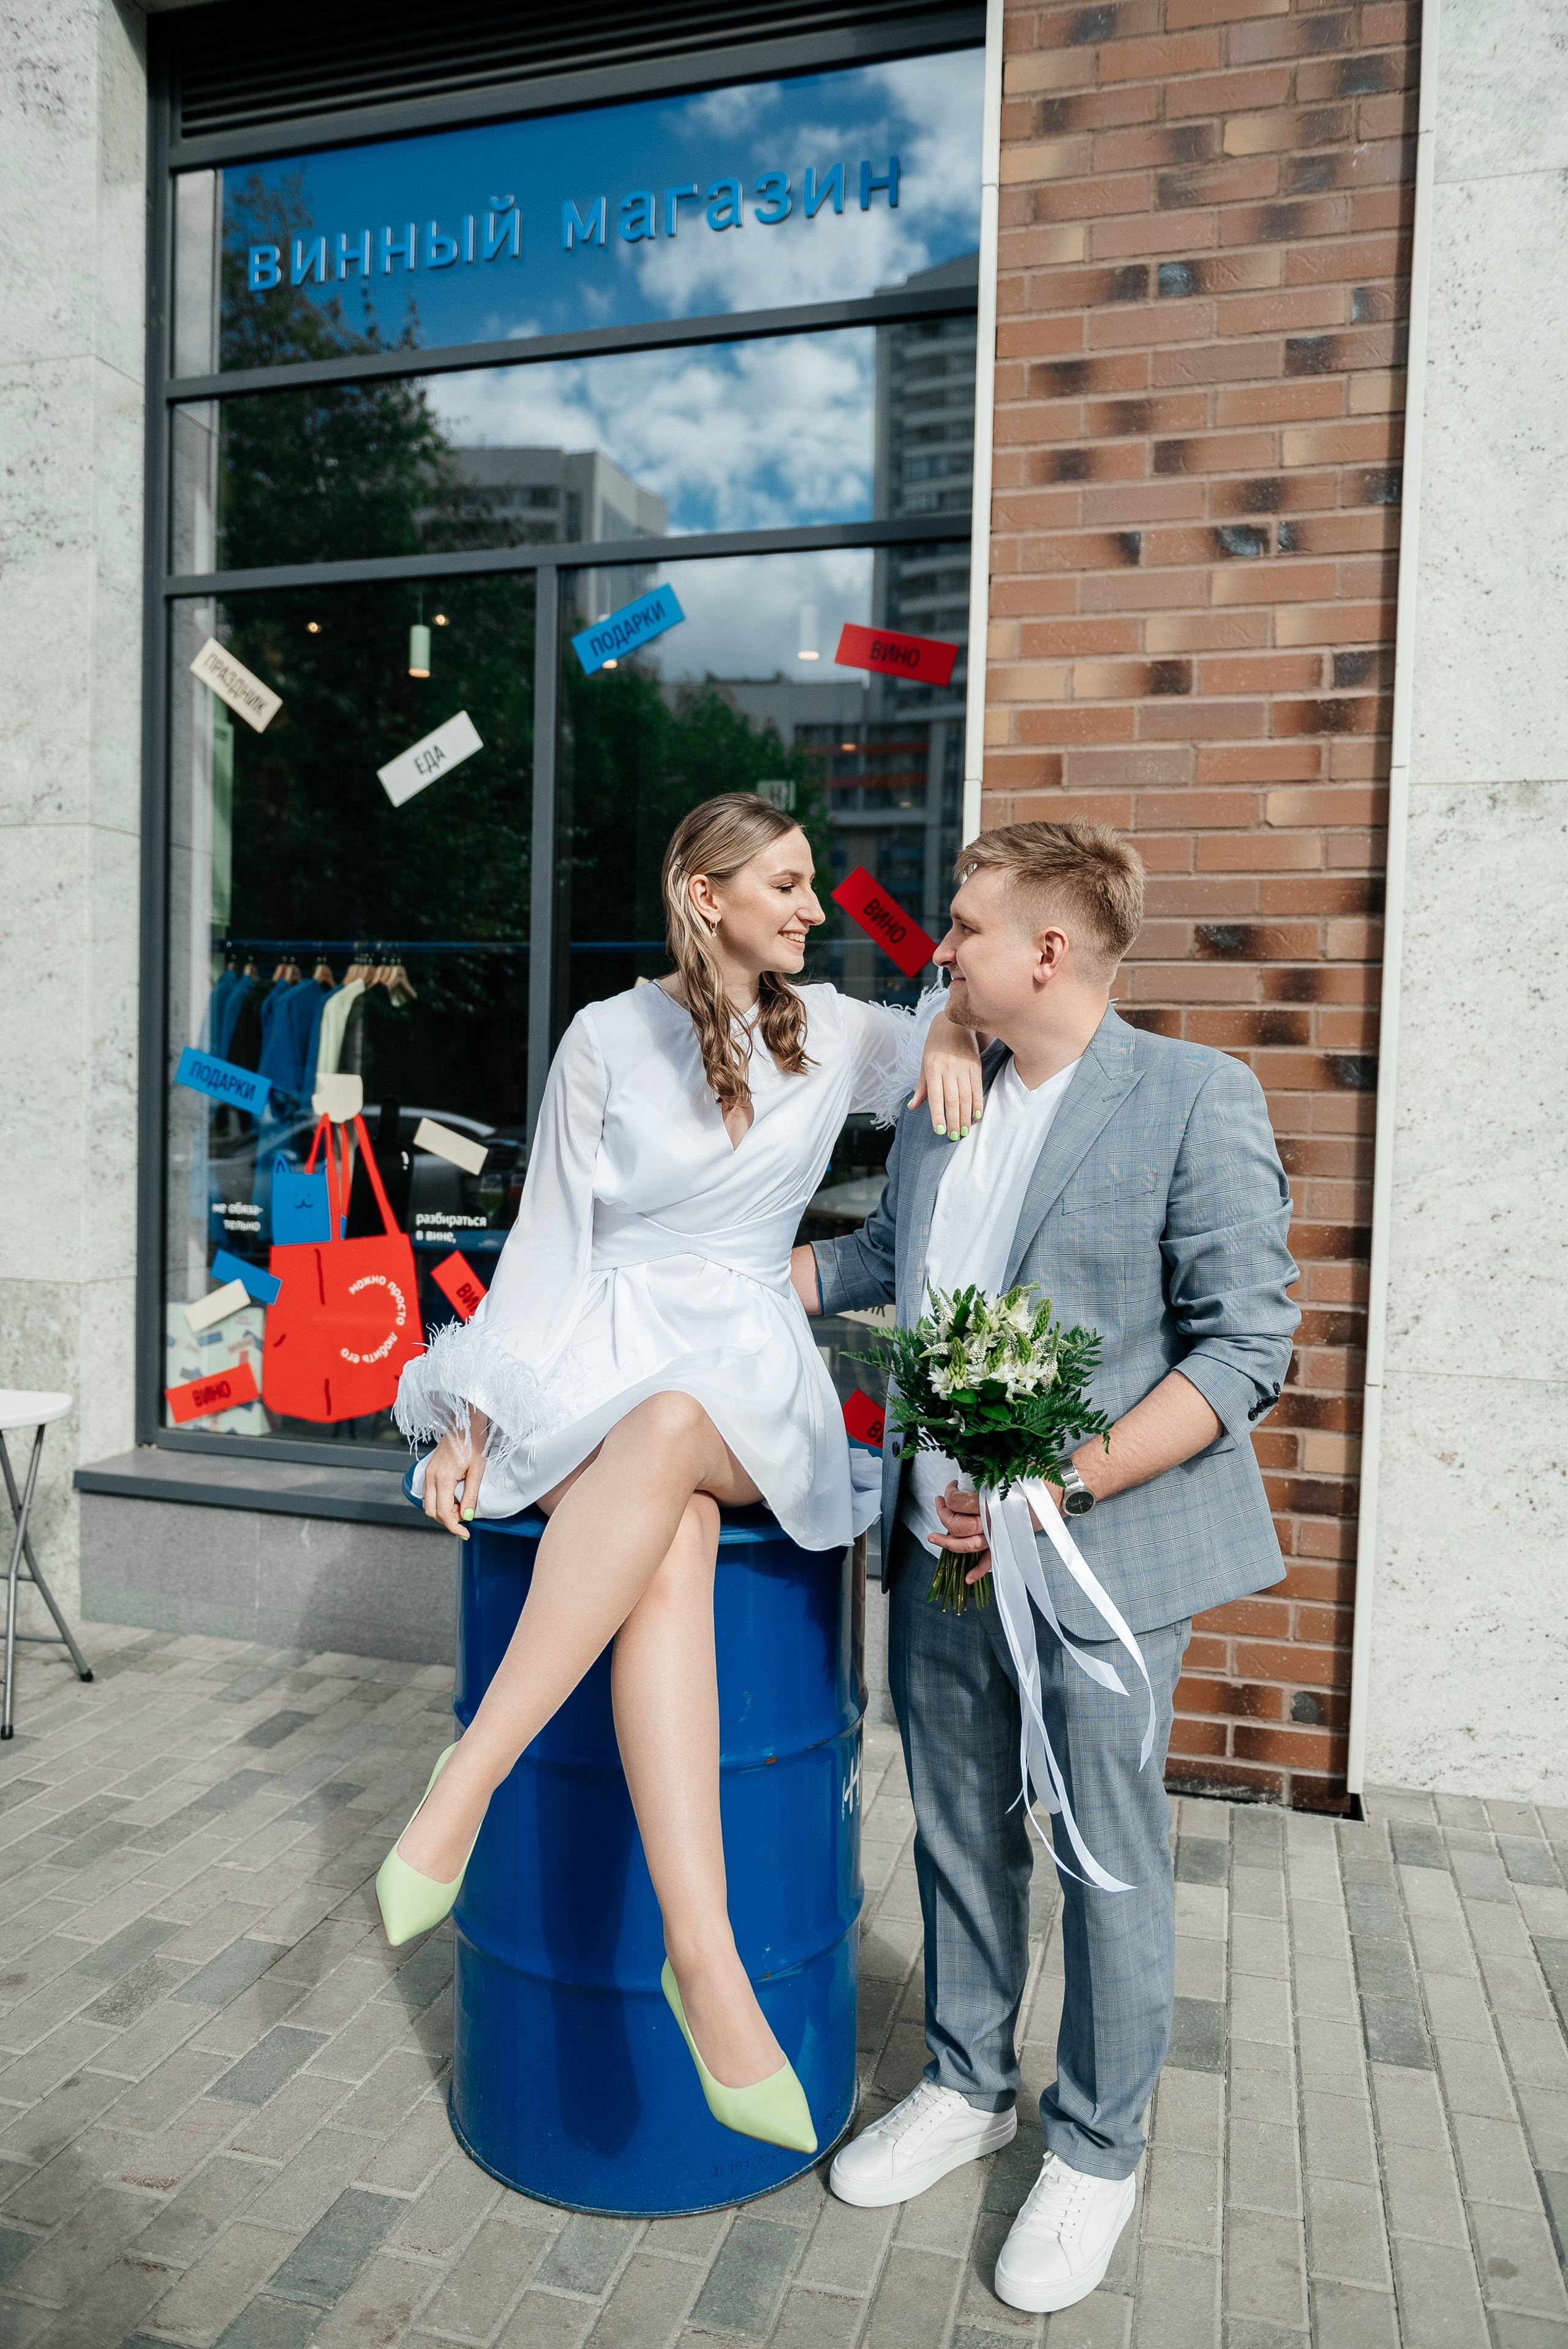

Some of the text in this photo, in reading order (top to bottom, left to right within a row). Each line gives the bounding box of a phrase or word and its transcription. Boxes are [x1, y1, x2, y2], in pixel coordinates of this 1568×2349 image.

[247, 156, 901, 293] винный магазин
[589, 600, 667, 657] ПОДАРКИ
[870, 640, 921, 668] ВИНО
[203, 652, 269, 717] ПРАЗДНИК
[413, 745, 447, 774] ЕДА
[862, 898, 907, 943] ВИНО
[189, 1060, 256, 1101] ПОДАРКИ
[223, 1220, 261, 1231] тельно
[416, 1212, 487, 1228] разбираться
[416, 1230, 424, 1240] в
[341, 1273, 406, 1364] можно просто любить его
[192, 1381, 232, 1408] ВИНО
